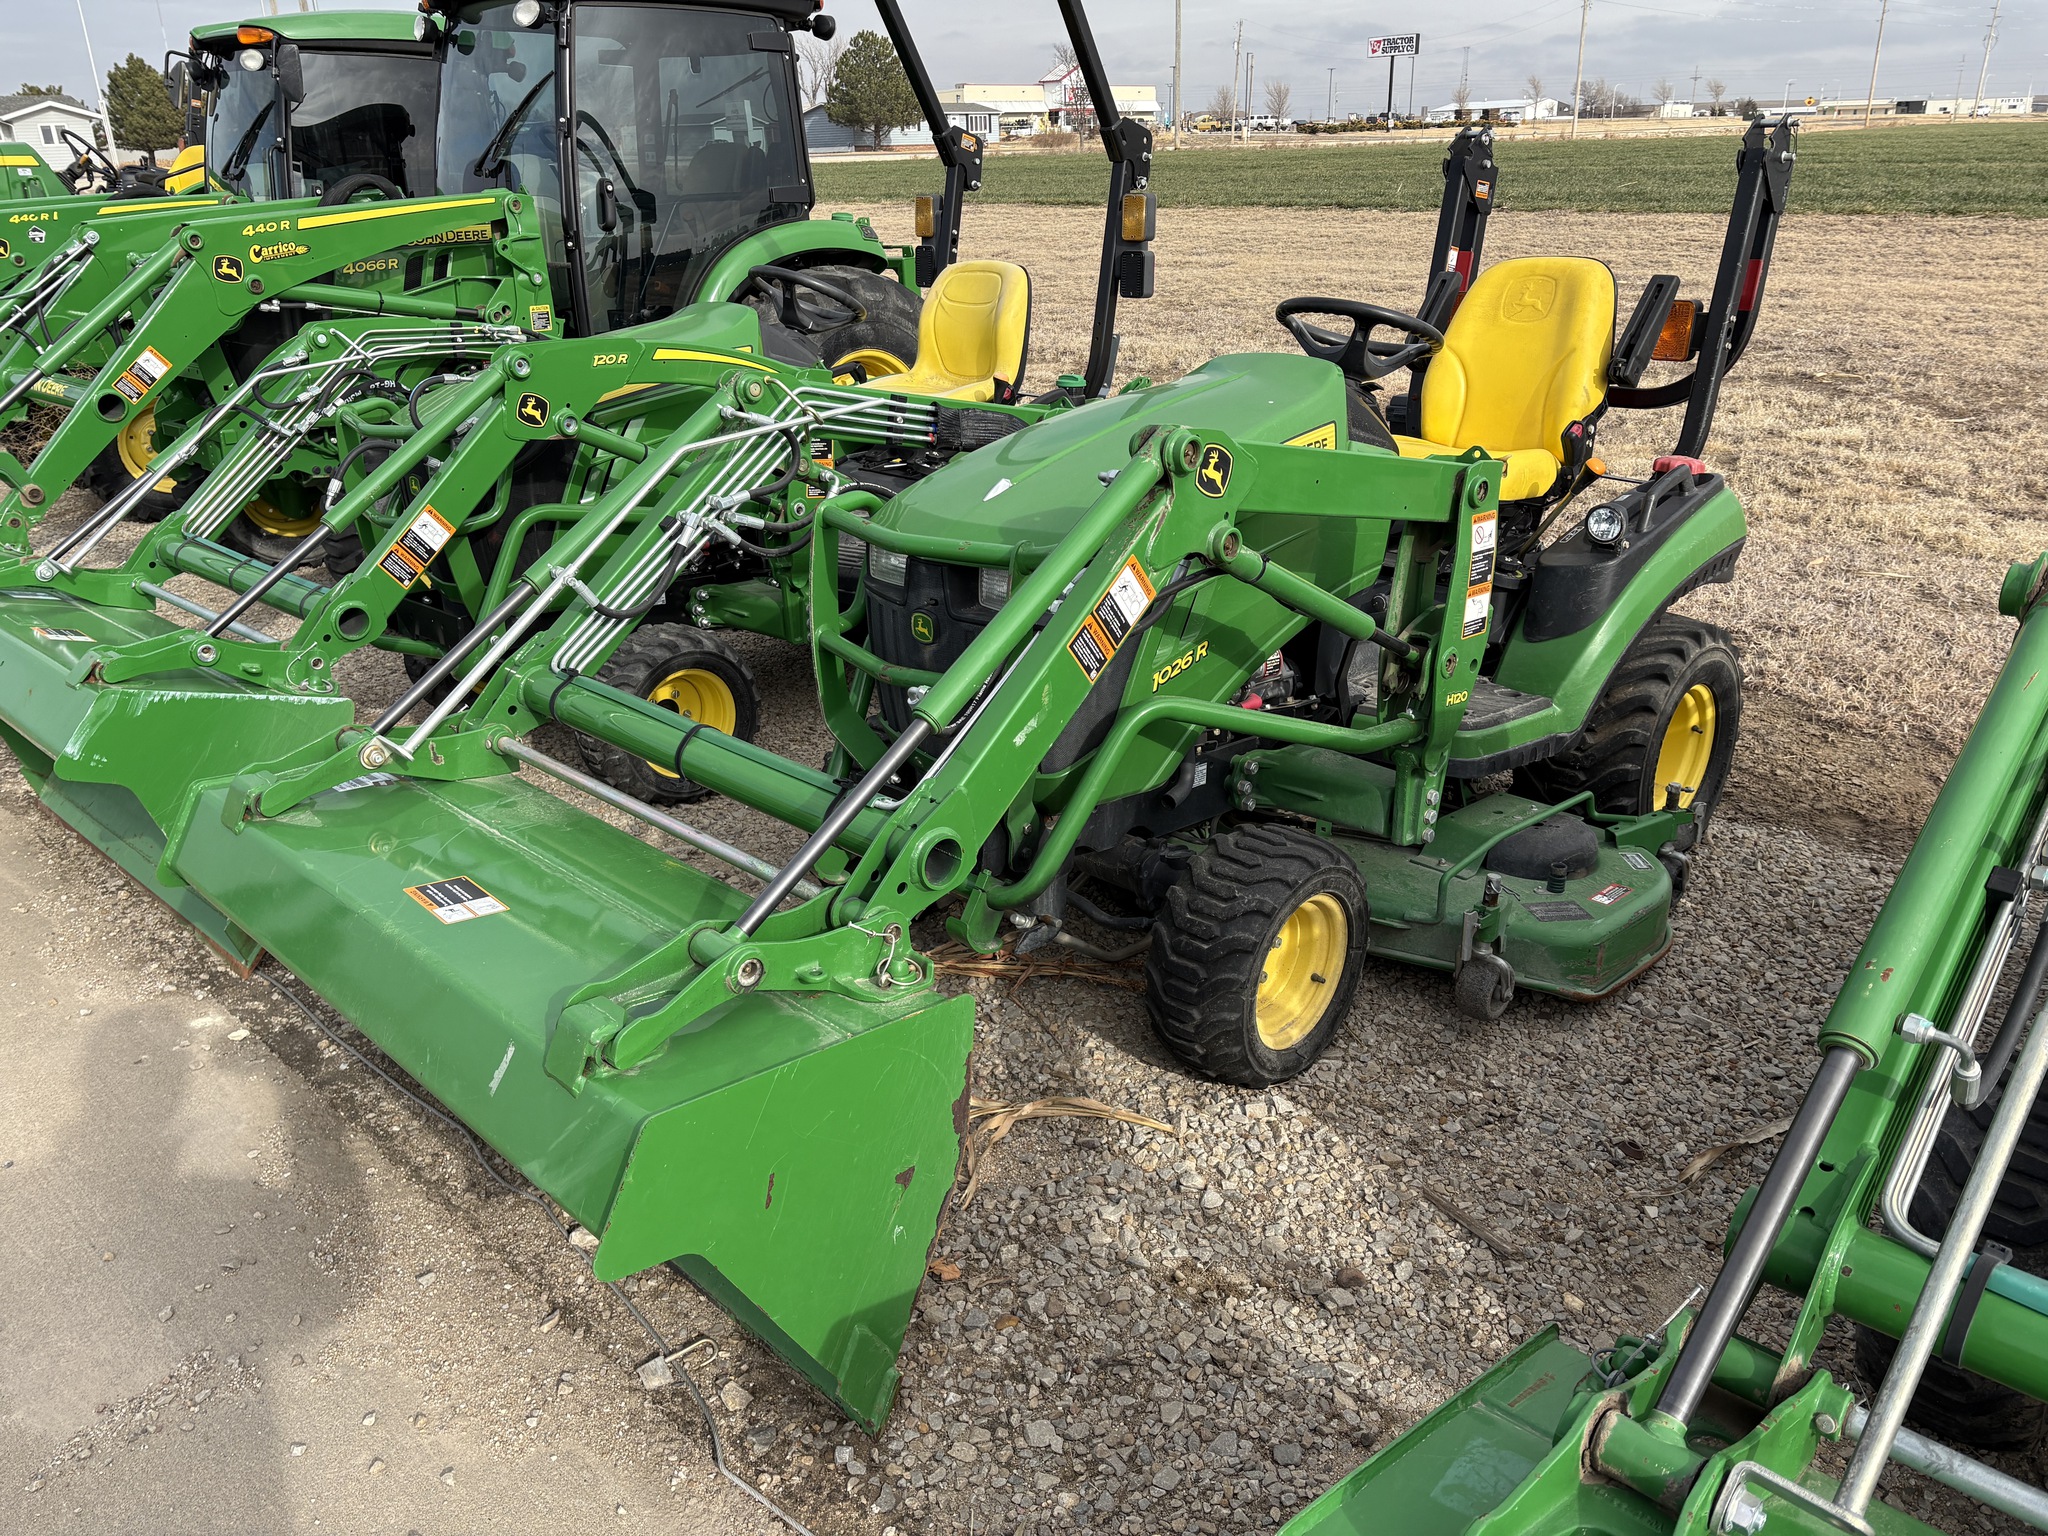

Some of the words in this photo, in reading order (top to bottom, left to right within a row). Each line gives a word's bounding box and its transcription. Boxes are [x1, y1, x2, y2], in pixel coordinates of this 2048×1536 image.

[1381, 44, 1406, 54] SUPPLY
[1382, 36, 1414, 46] TRACTOR
[40, 212, 50, 220] R
[242, 222, 278, 236] 440
[280, 220, 290, 230] R
[444, 230, 489, 242] DEERE
[249, 241, 296, 264] Carrico
[342, 260, 386, 275] 4066
[388, 258, 399, 270] R
[592, 354, 616, 368] 120
[618, 354, 628, 364] R
[433, 512, 452, 531] WARNING
[400, 553, 420, 570] WARNING
[1135, 570, 1151, 596] WARNING
[1093, 629, 1110, 656] WARNING
[1152, 650, 1194, 693] 1026
[1196, 640, 1209, 662] R
[1446, 690, 1468, 707] H120
